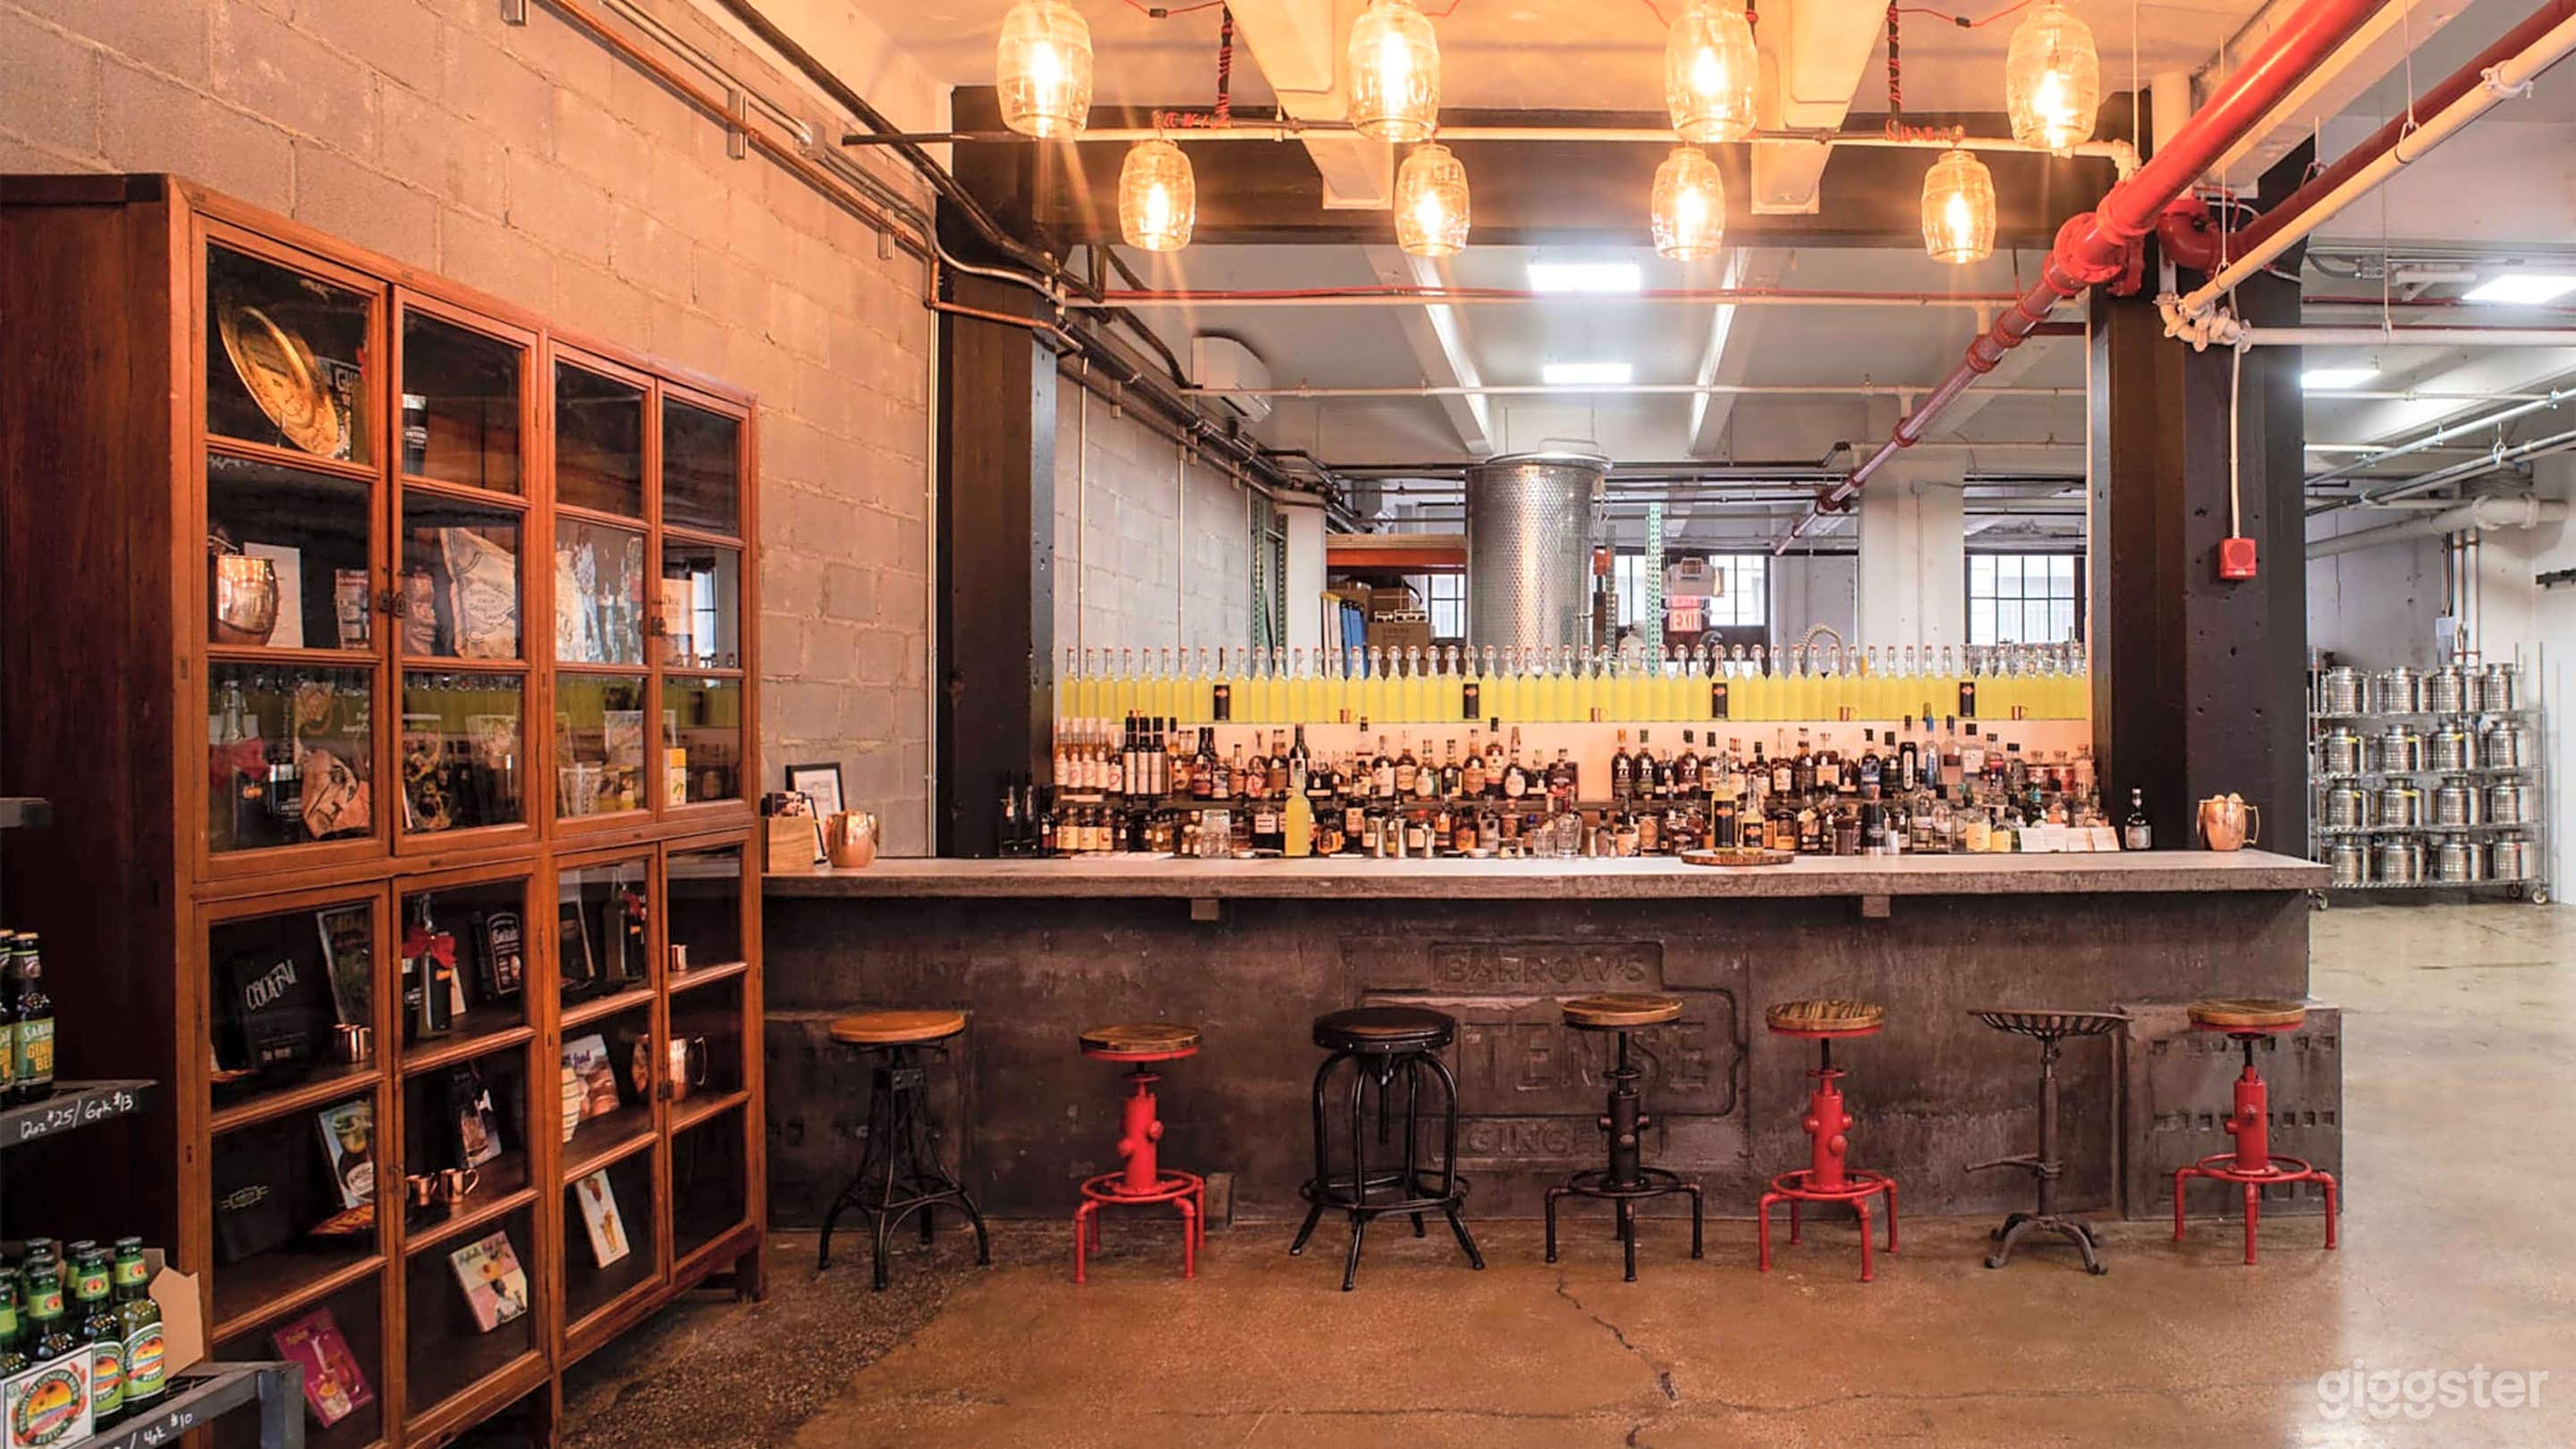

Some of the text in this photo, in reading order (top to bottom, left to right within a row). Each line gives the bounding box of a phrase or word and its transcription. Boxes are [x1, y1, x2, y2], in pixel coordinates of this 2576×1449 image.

[1674, 610, 1698, 631] EXIT
[1444, 954, 1646, 983] BARROW'S
[1467, 1124, 1610, 1155] GINGE
